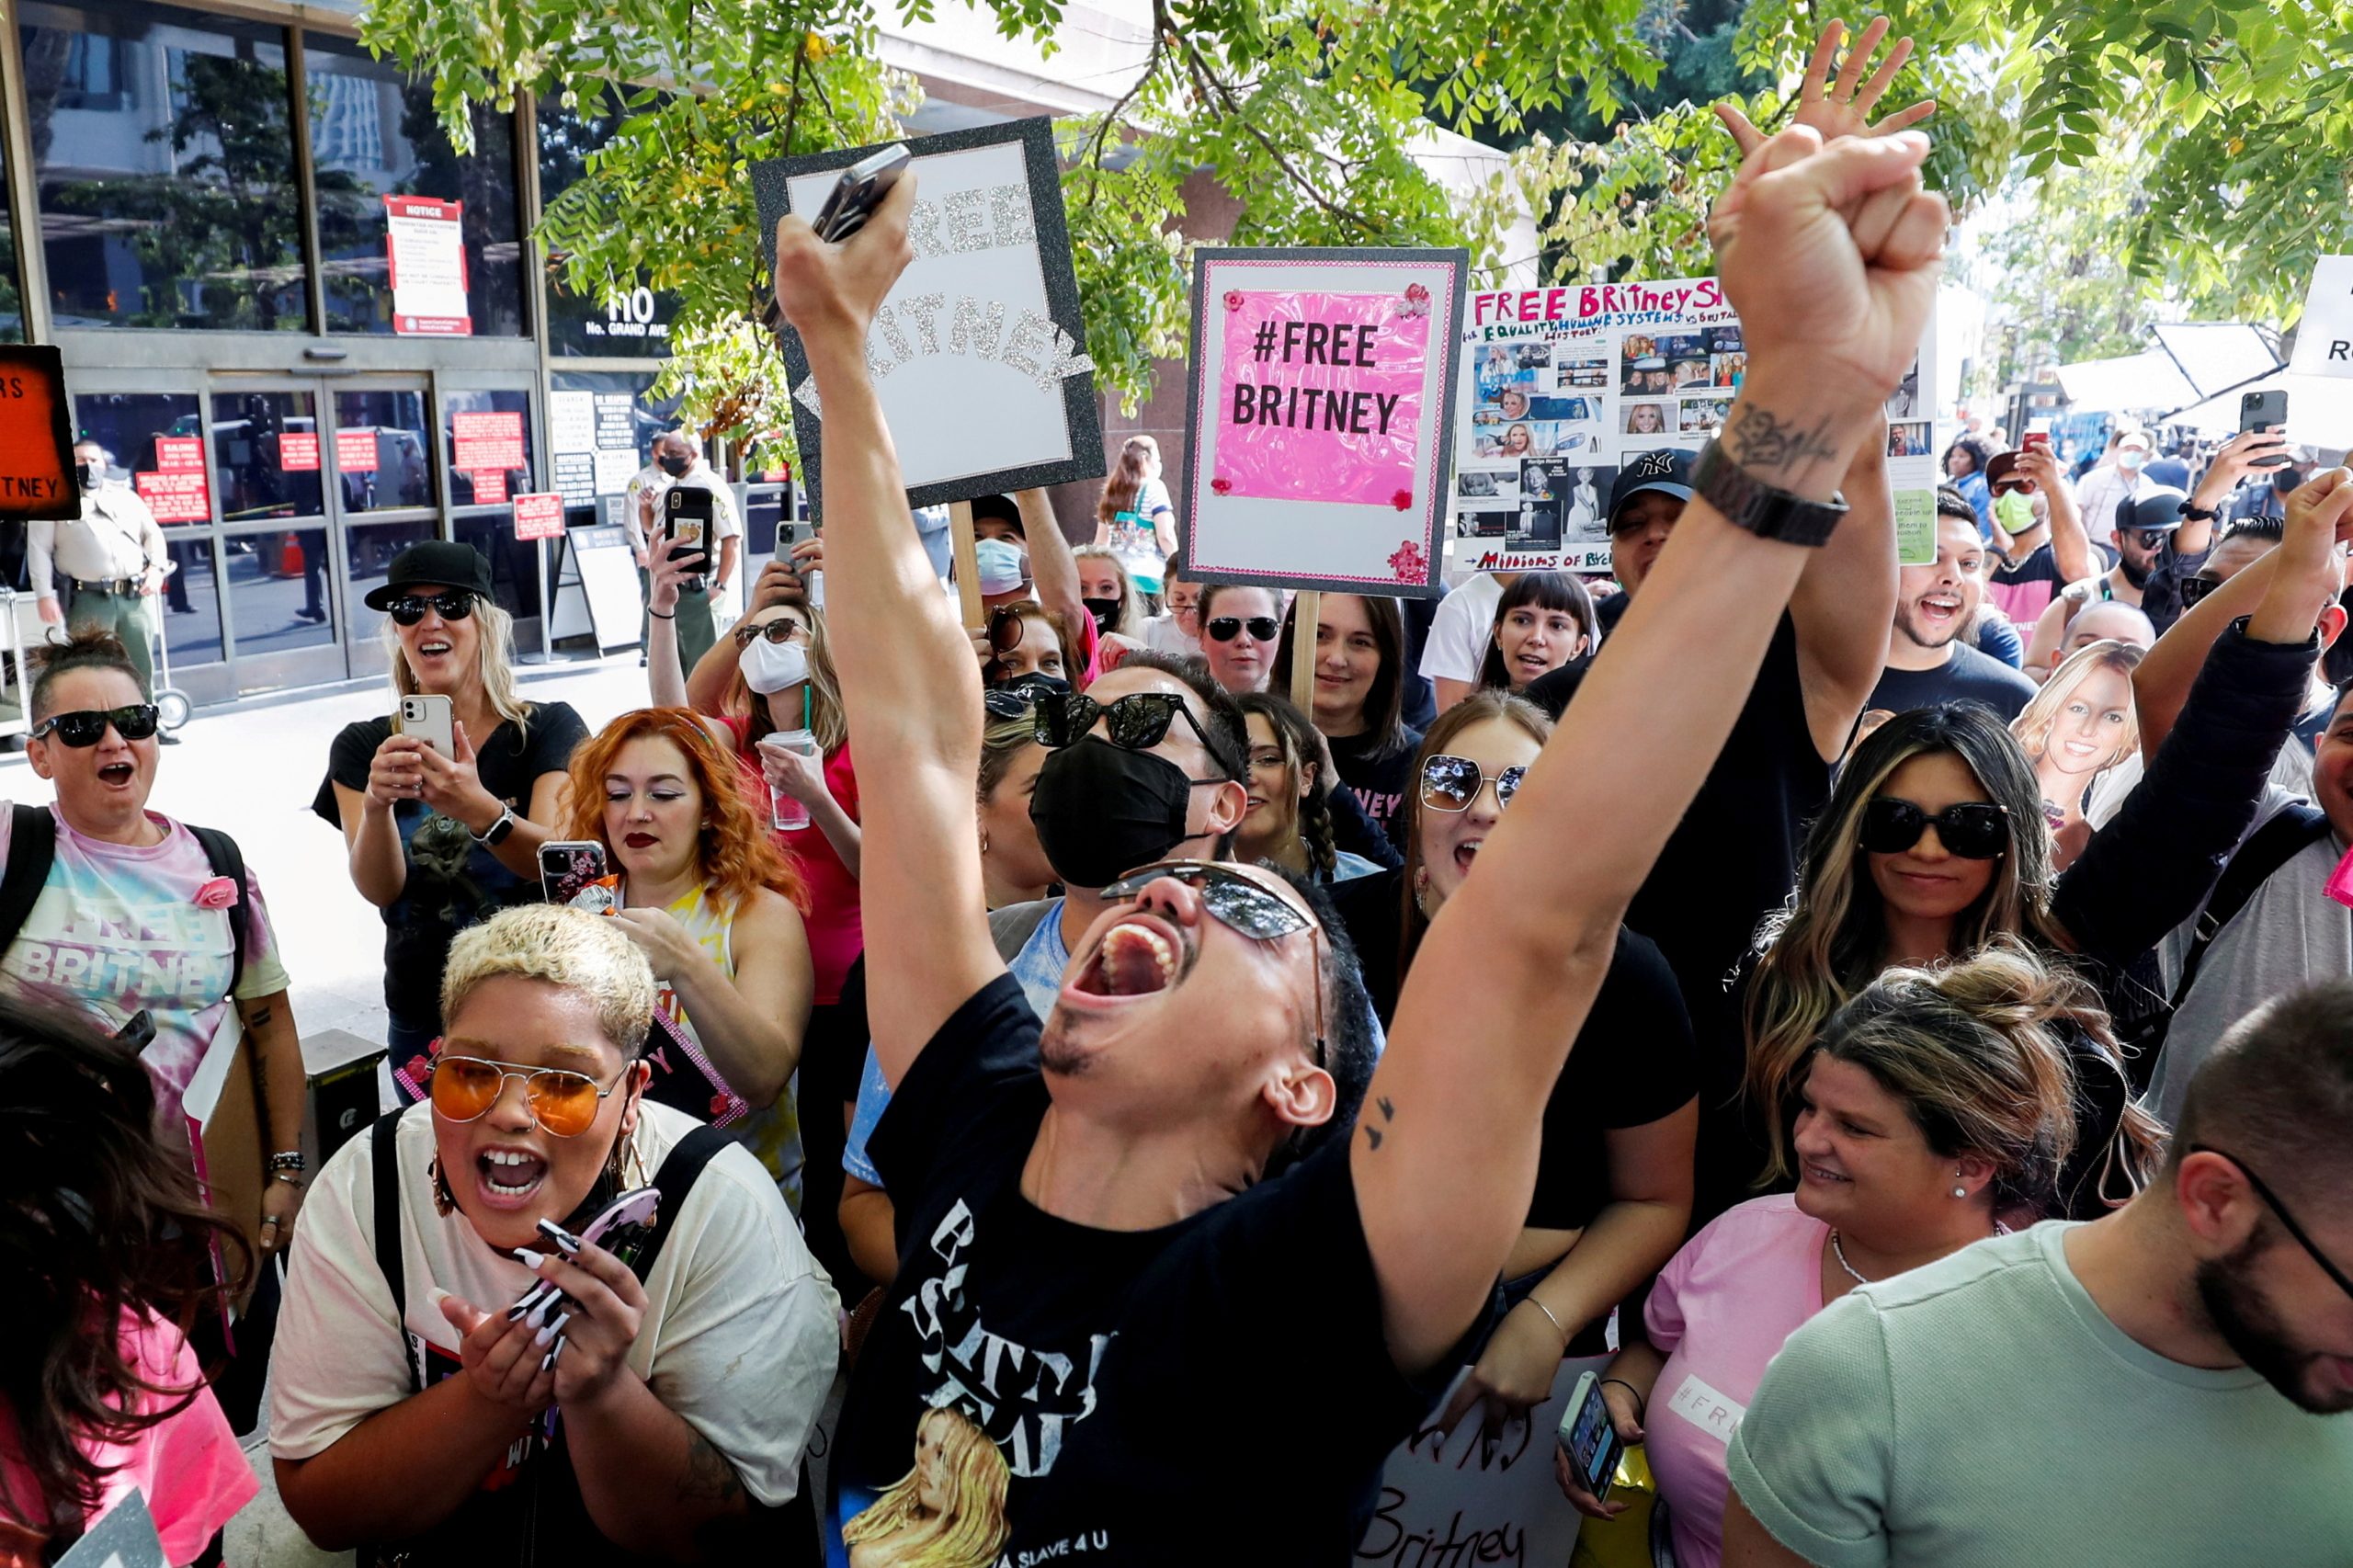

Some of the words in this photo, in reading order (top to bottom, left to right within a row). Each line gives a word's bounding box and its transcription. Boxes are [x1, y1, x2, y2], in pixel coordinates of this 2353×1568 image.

[405, 205, 443, 218] NOTICE
[907, 183, 1038, 262] REE
[1474, 289, 1567, 326] FREE
[1693, 280, 1723, 308] S
[585, 321, 606, 335] No.
[608, 322, 646, 336] GRAND
[1253, 321, 1379, 368] #FREE
[2328, 339, 2353, 361] R
[1233, 383, 1400, 436] BRITNEY
[1347, 787, 1403, 817] NEY
[1356, 1486, 1525, 1568] Britney
[1017, 1538, 1070, 1568] SLAVE
[1074, 1532, 1088, 1551] 4
[1093, 1529, 1108, 1550] U
